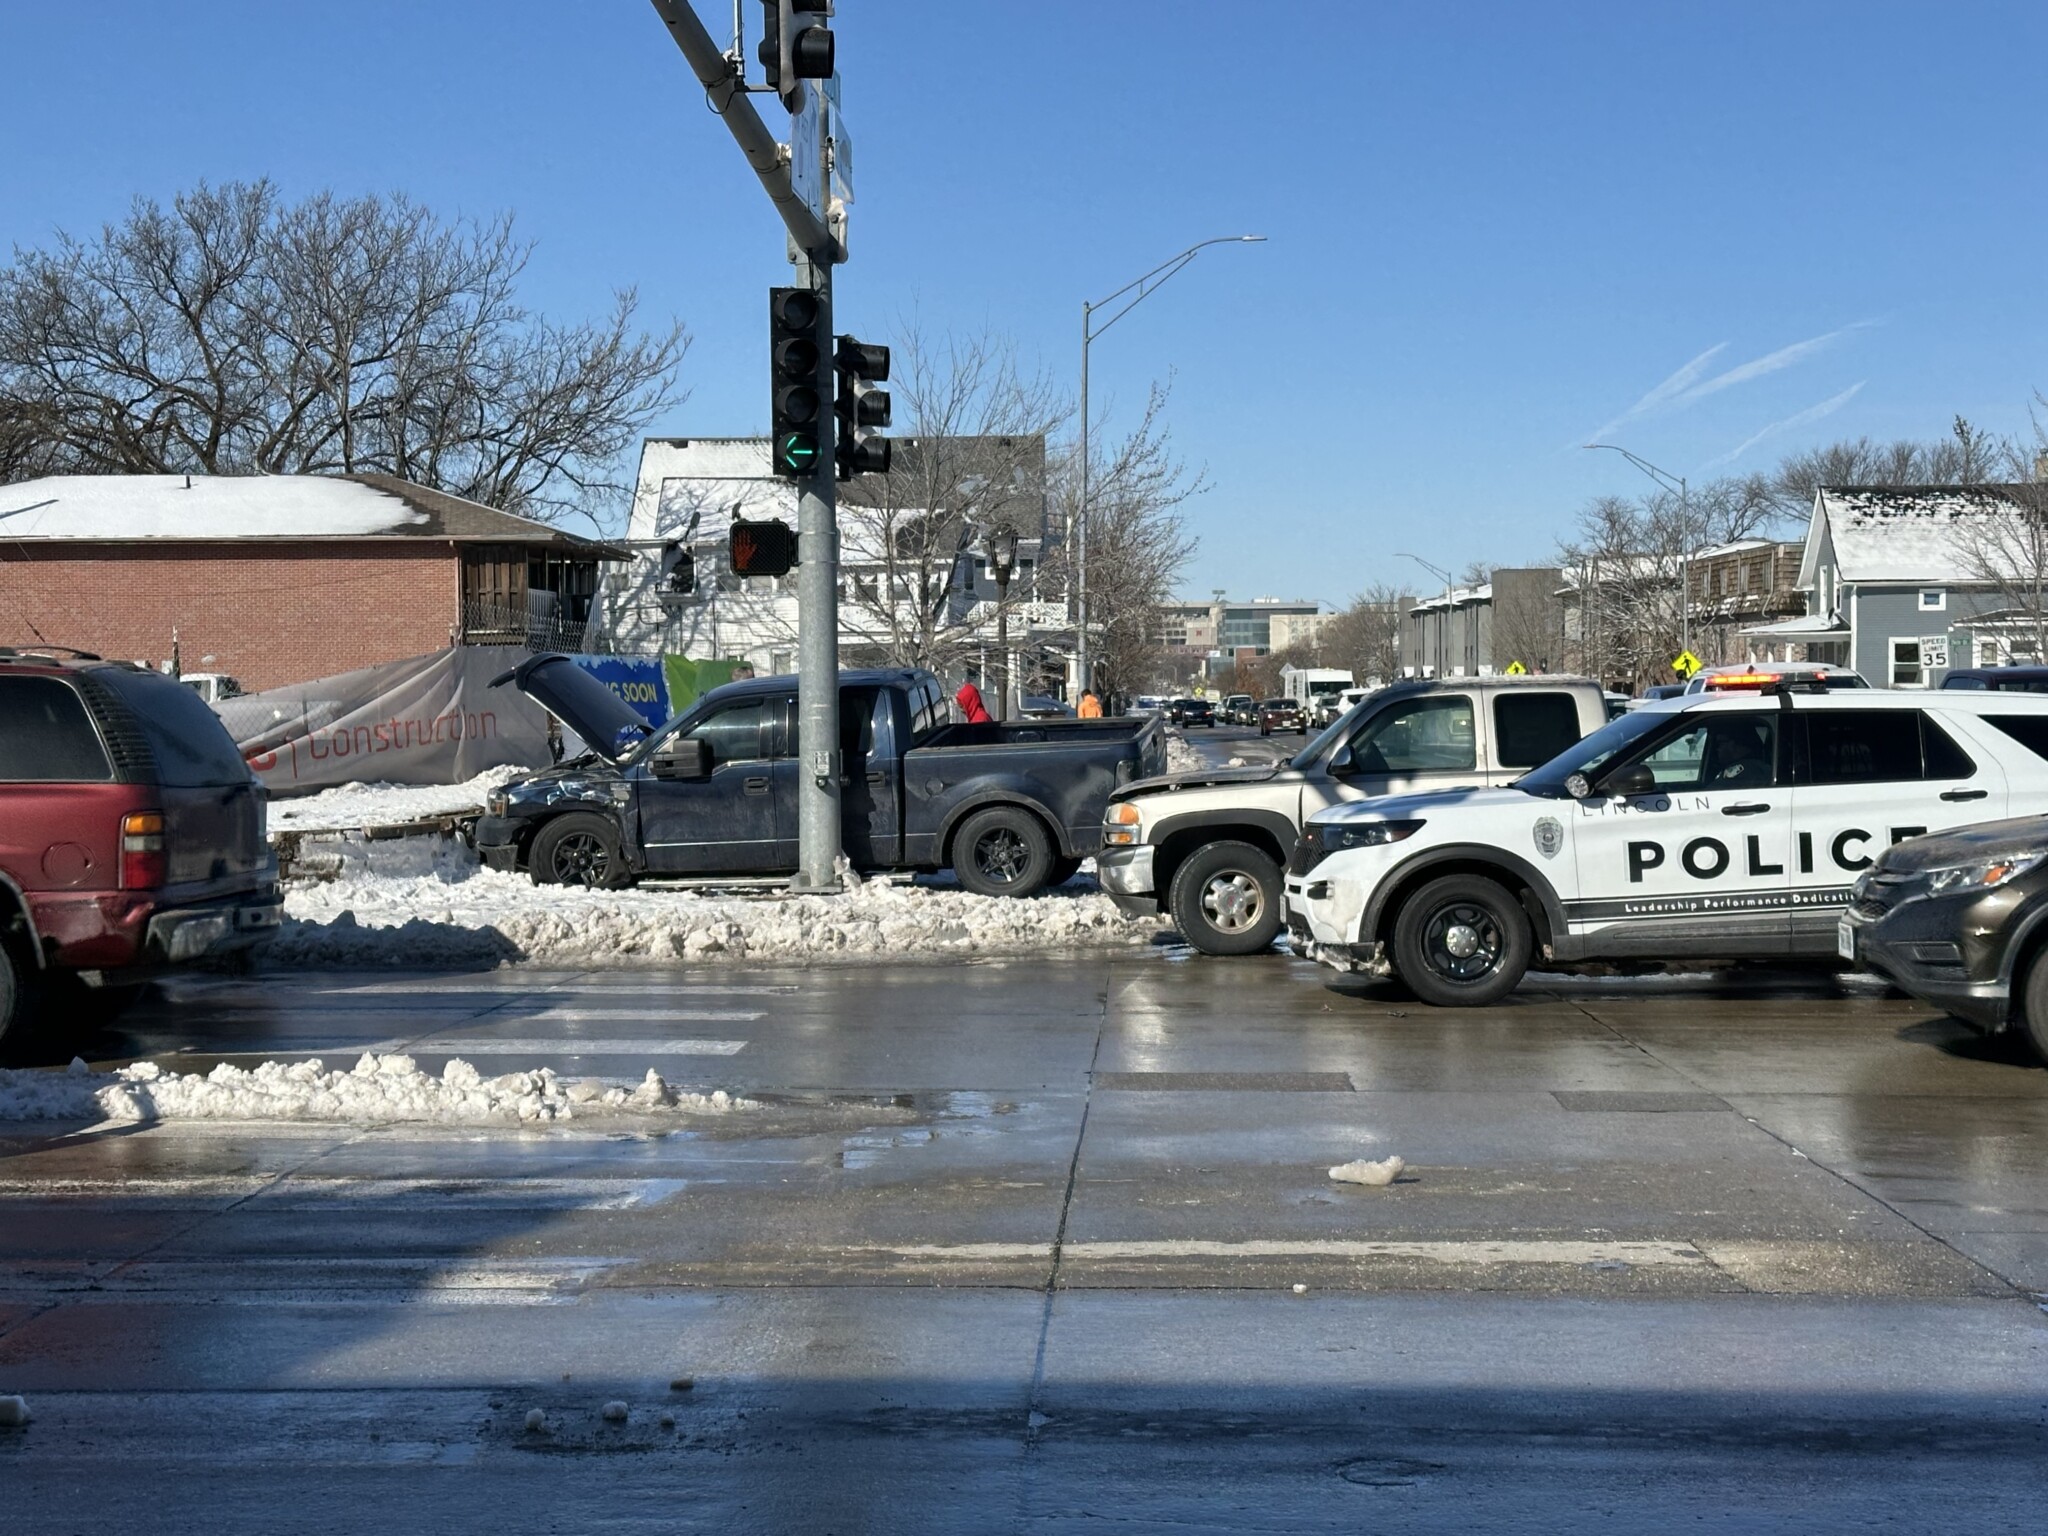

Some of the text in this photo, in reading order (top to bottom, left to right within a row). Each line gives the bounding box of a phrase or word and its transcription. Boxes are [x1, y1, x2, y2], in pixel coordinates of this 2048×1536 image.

[1921, 637, 1946, 645] SPEED
[1923, 645, 1943, 653] LIMIT
[1923, 653, 1947, 666] 35
[622, 682, 658, 703] SOON
[1581, 797, 1710, 817] LINCOLN
[1626, 826, 1928, 883] POLIC
[1625, 901, 1697, 912] Leadership
[1704, 898, 1786, 908] Performance
